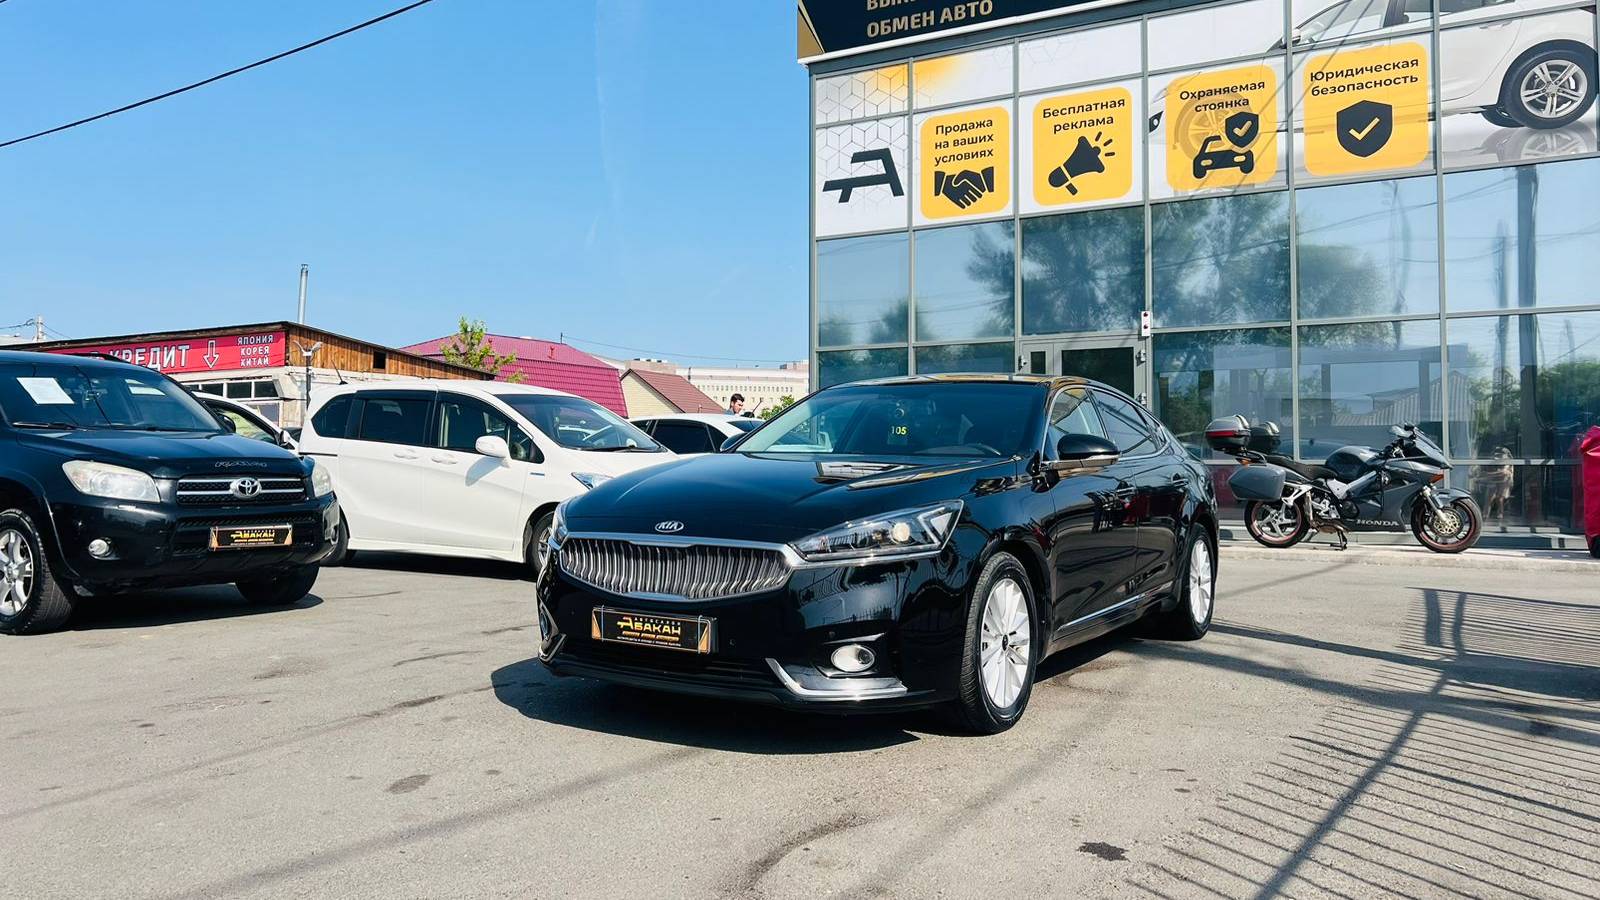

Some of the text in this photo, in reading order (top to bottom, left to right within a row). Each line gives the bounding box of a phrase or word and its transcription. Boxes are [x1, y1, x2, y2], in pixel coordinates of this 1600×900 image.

[867, 10, 935, 38] ОБМЕН
[940, 0, 993, 24] АВТО
[1310, 59, 1419, 82] Юридическая
[1180, 81, 1265, 100] Охраняемая
[1311, 75, 1419, 96] безопасность
[1043, 98, 1125, 118] Бесплатная
[1195, 98, 1249, 112] стоянка
[935, 119, 993, 136] Продажа
[1053, 116, 1114, 134] реклама
[935, 134, 994, 149] на ваших
[934, 149, 994, 167] условиях
[238, 334, 273, 346] ЯПОНИЯ
[240, 345, 270, 356] КОРЕЯ
[240, 355, 269, 367] КИТАЙ
[891, 425, 907, 435] 105
